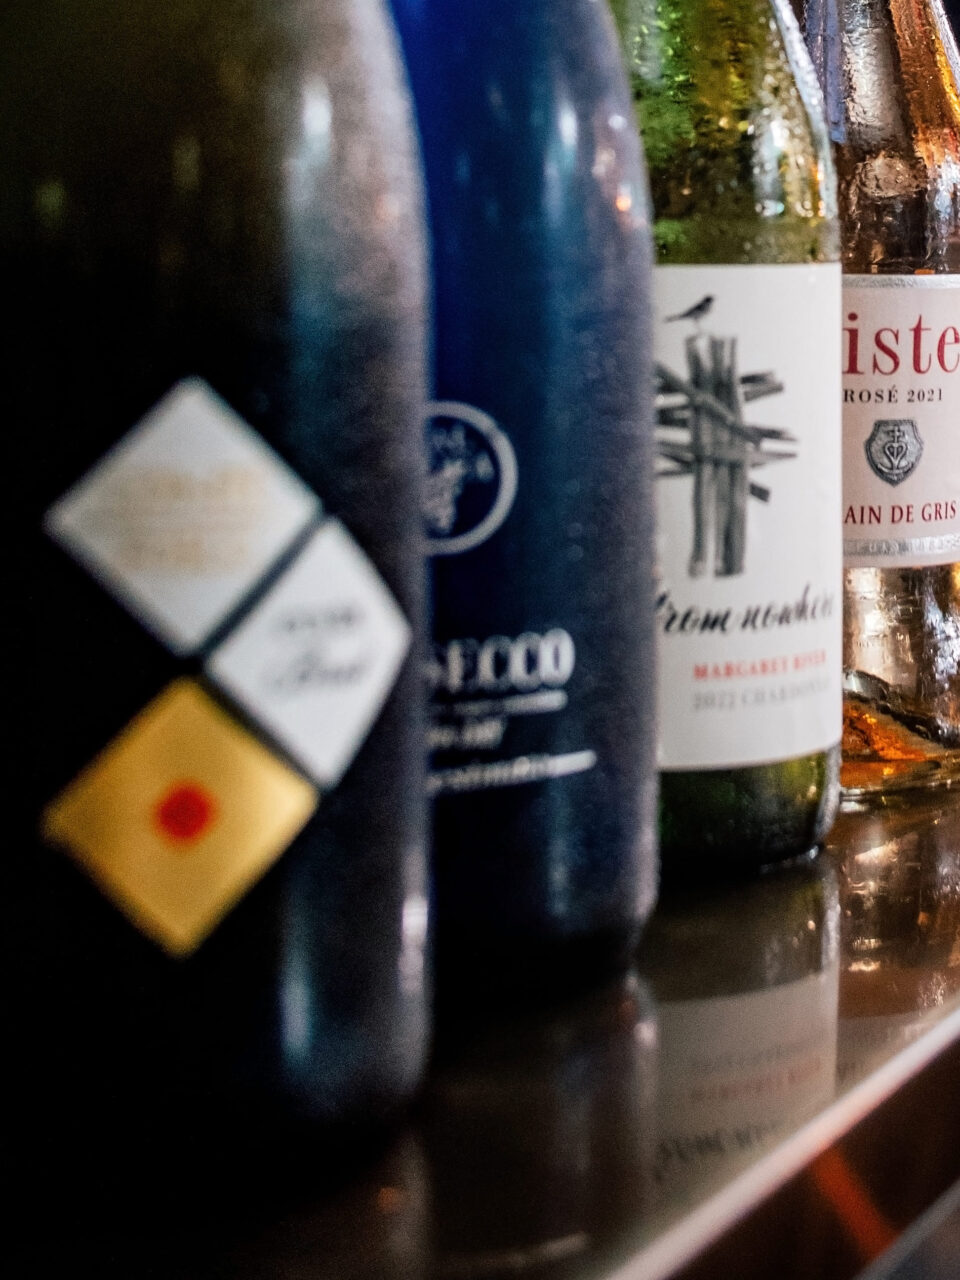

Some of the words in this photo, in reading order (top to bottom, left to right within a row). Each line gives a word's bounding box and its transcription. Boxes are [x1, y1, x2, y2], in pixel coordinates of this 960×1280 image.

[843, 385, 898, 404] ROSÉ
[907, 388, 943, 403] 2021
[891, 503, 914, 525] DE
[921, 500, 957, 523] GRIS
